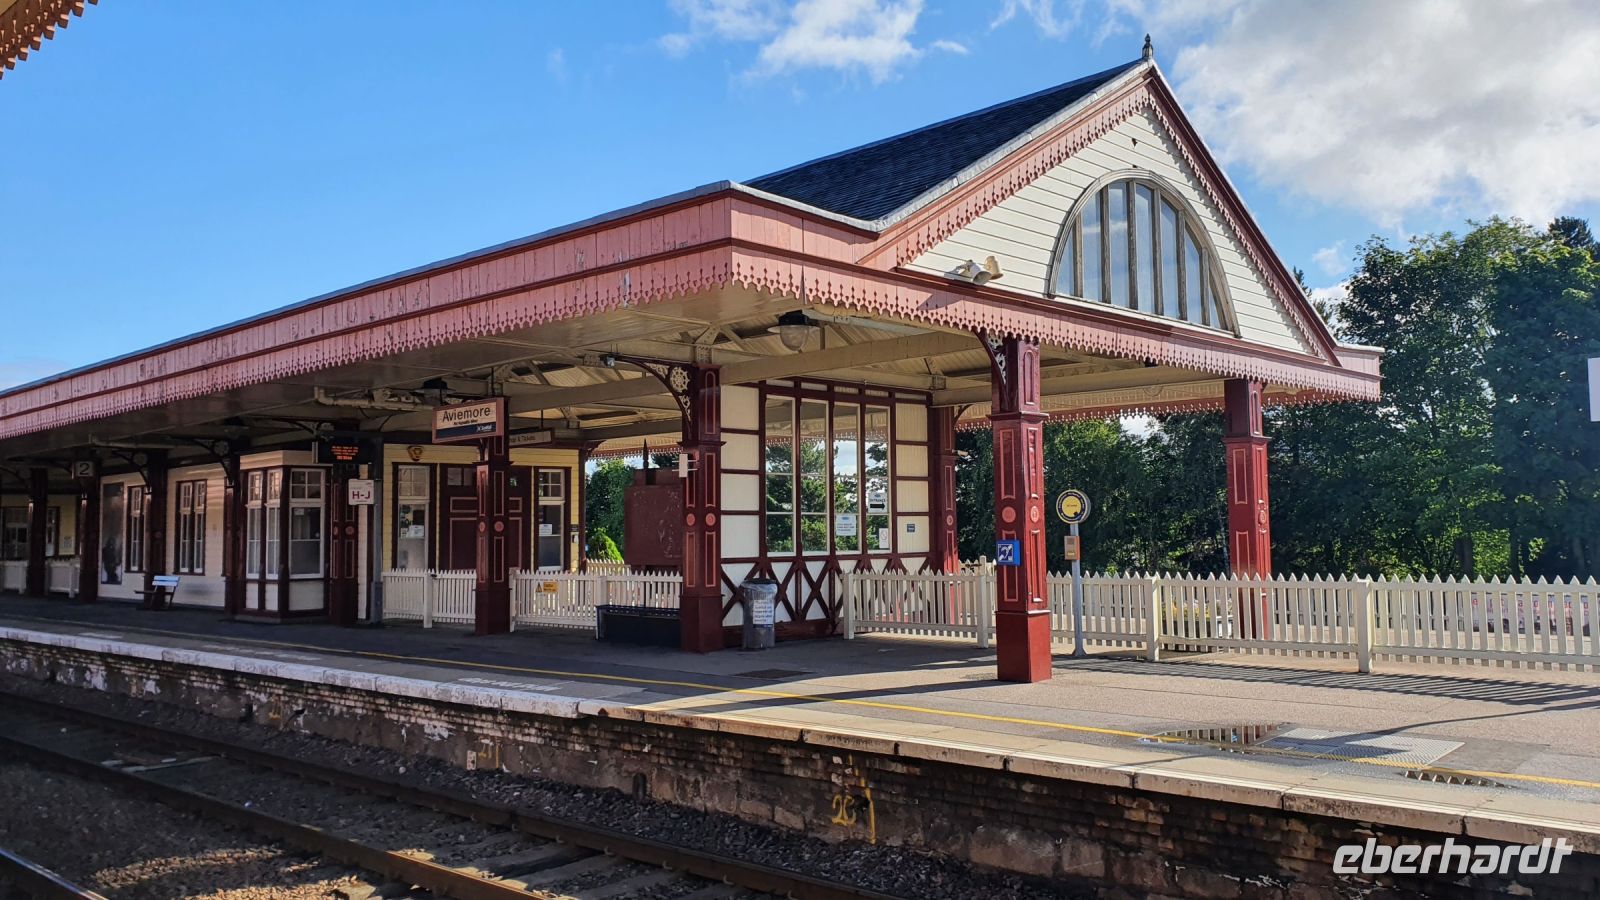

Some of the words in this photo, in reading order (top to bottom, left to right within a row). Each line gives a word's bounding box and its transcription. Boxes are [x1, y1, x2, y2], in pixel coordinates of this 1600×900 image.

[442, 407, 491, 422] Aviemore
[79, 462, 90, 475] 2
[352, 490, 371, 500] H-J
